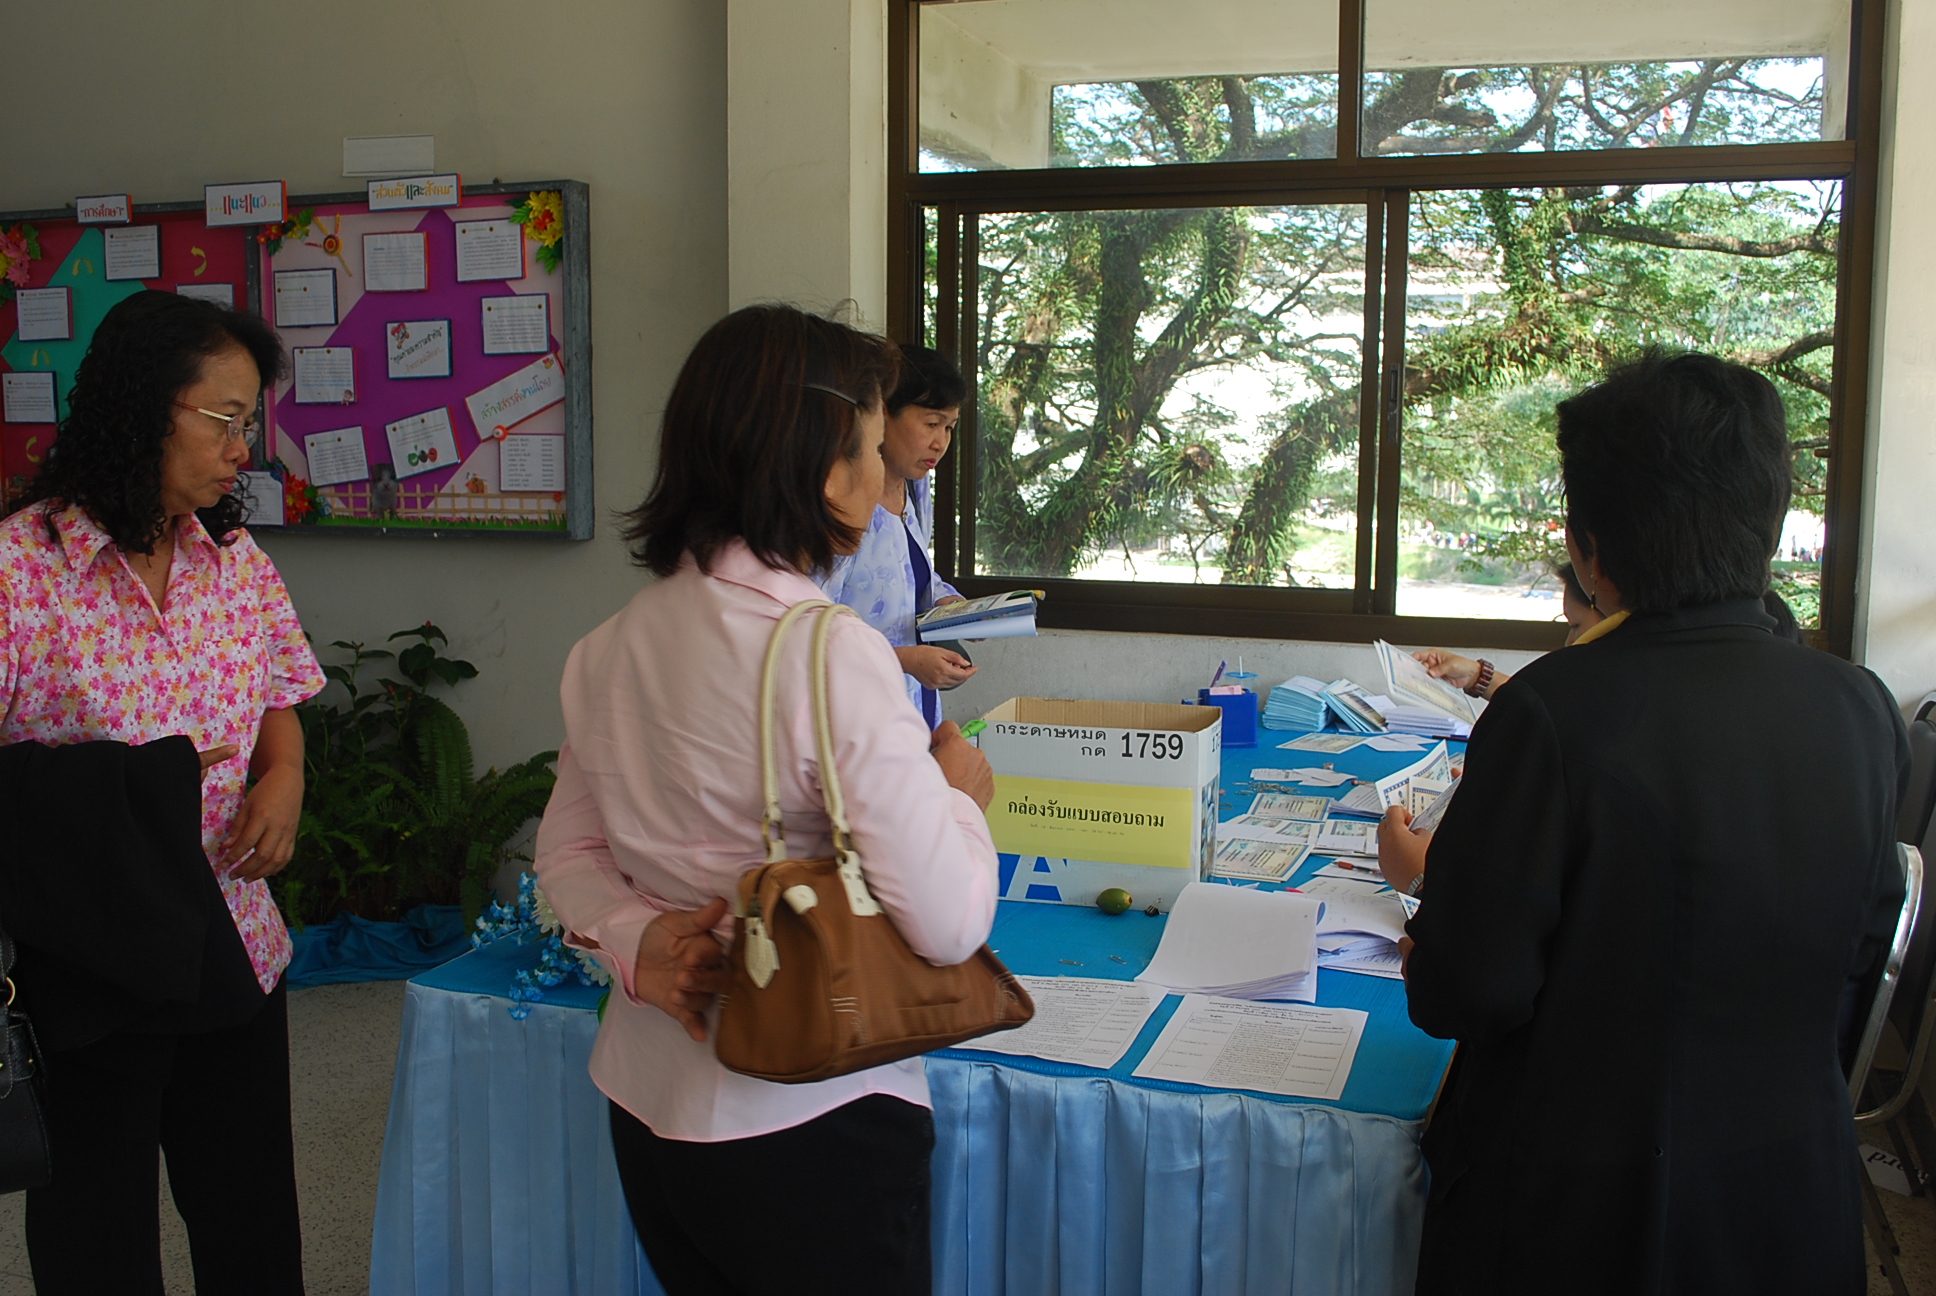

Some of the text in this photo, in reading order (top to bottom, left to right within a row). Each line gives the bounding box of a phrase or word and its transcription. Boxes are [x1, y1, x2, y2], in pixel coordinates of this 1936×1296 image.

[994, 723, 1107, 741] กระดาษหมด
[1080, 732, 1184, 760] กด 1759
[1007, 796, 1165, 828] กล่องรับแบบสอบถาม
